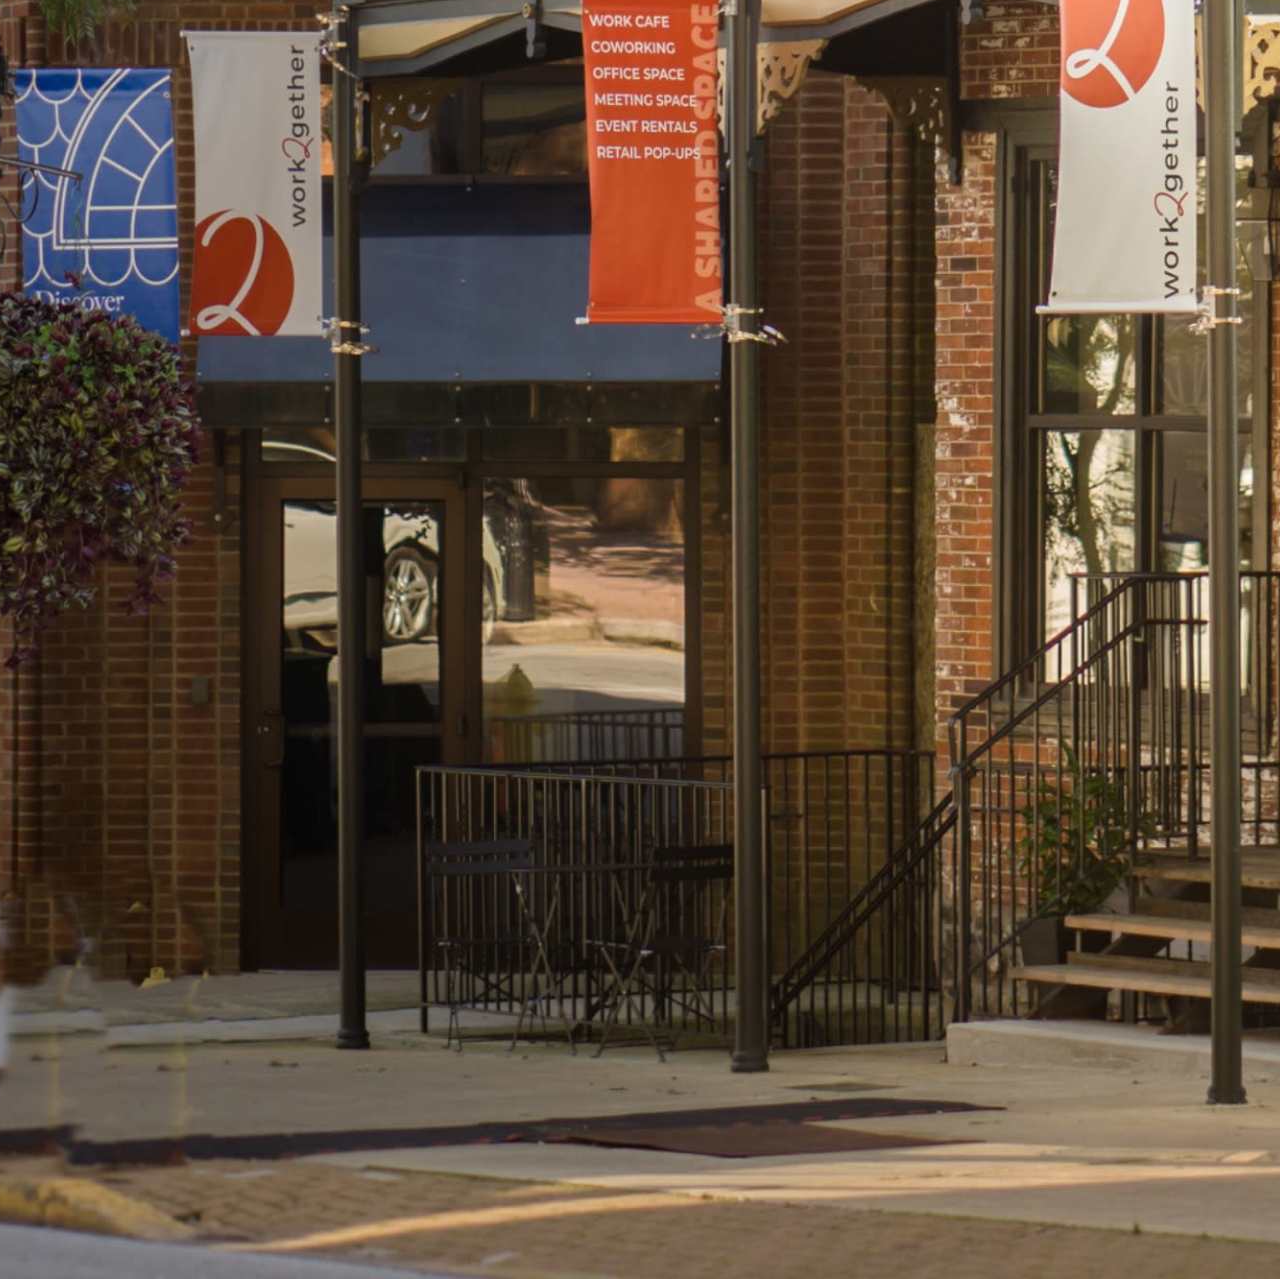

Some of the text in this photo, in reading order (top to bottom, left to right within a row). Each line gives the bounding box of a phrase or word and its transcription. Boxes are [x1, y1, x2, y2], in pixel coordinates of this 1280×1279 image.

[589, 14, 670, 29] WORK CAFE
[591, 40, 676, 55] COWORKING
[592, 66, 686, 81] OFFICE SPACE
[594, 93, 698, 108] MEETING SPACE
[595, 119, 698, 134] EVENT RENTALS
[596, 145, 701, 161] RETAIL POP-UPS
[691, 3, 723, 315] A SHARED SPACE
